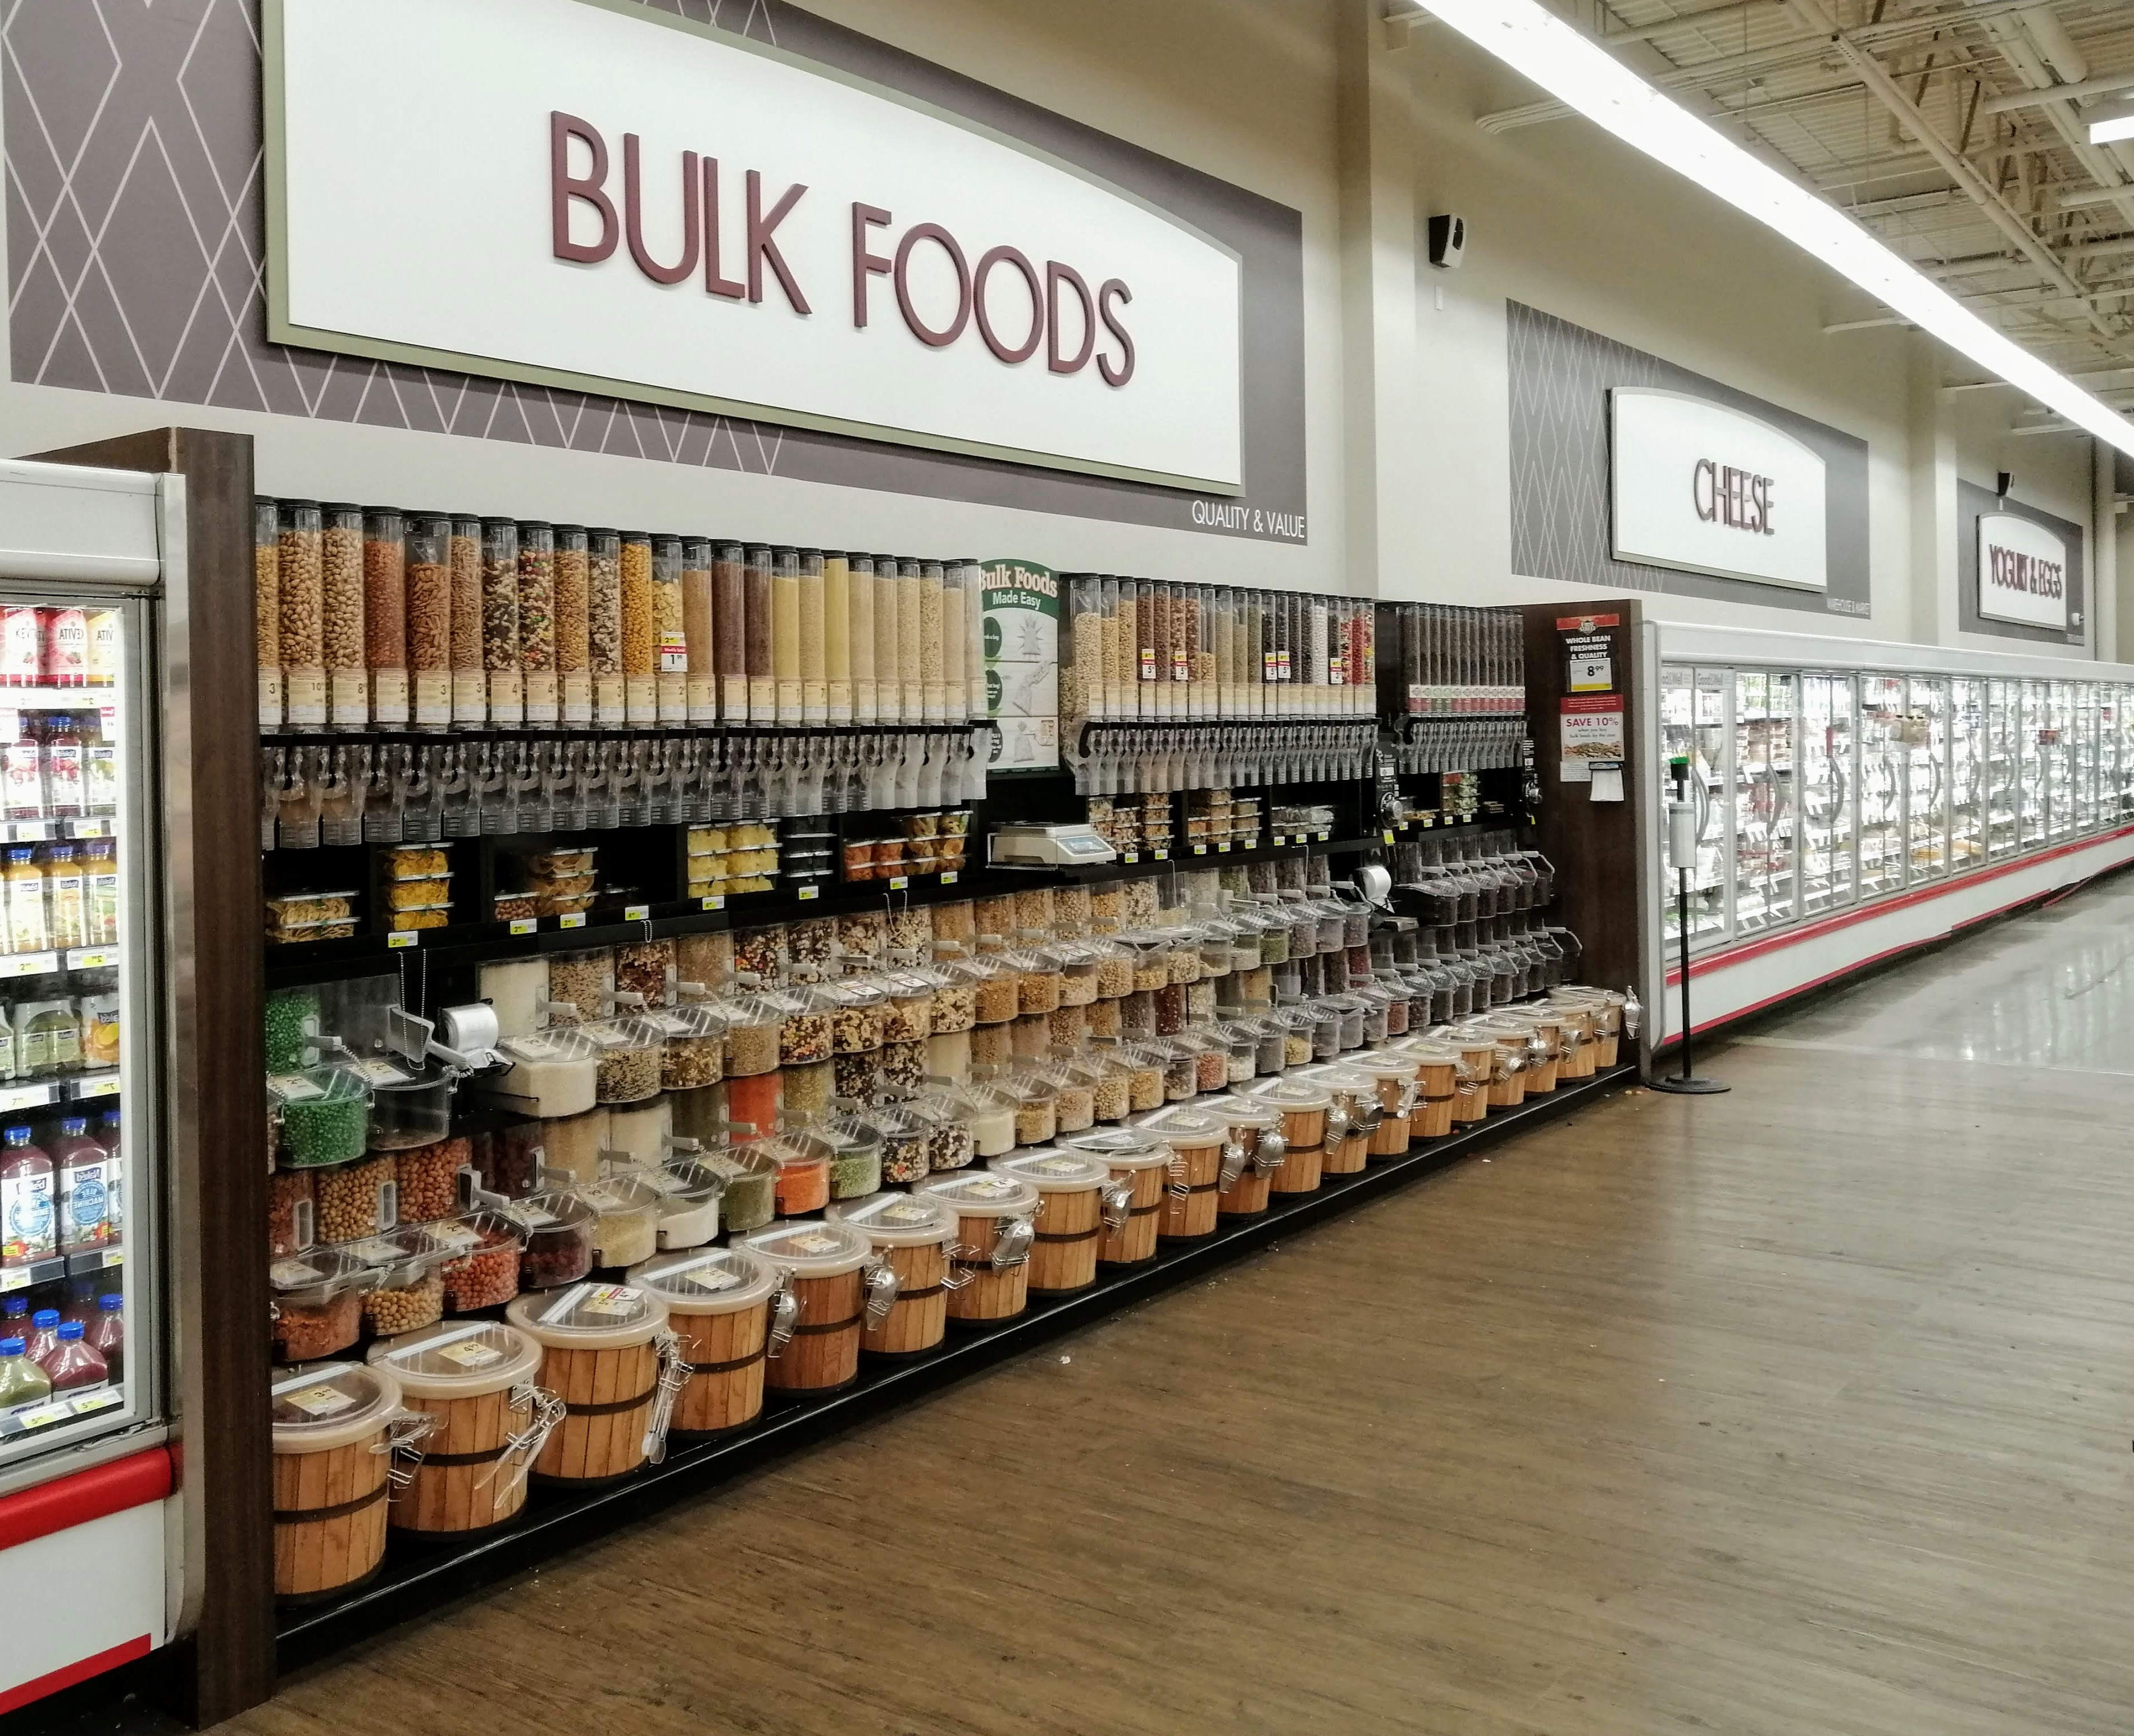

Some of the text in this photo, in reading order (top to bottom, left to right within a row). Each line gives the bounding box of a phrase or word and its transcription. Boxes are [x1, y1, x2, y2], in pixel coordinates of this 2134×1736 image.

[550, 110, 1135, 387] BULK FOODS
[1694, 458, 1774, 535] CHEESE
[1192, 499, 1305, 538] QUALITY & VALUE
[1014, 567, 1058, 598] Foods
[2038, 559, 2062, 600] EGGS
[992, 590, 1041, 610] Made Easy
[1570, 643, 1607, 652] FRESHNESS
[1566, 717, 1619, 727] SAVE 10%
